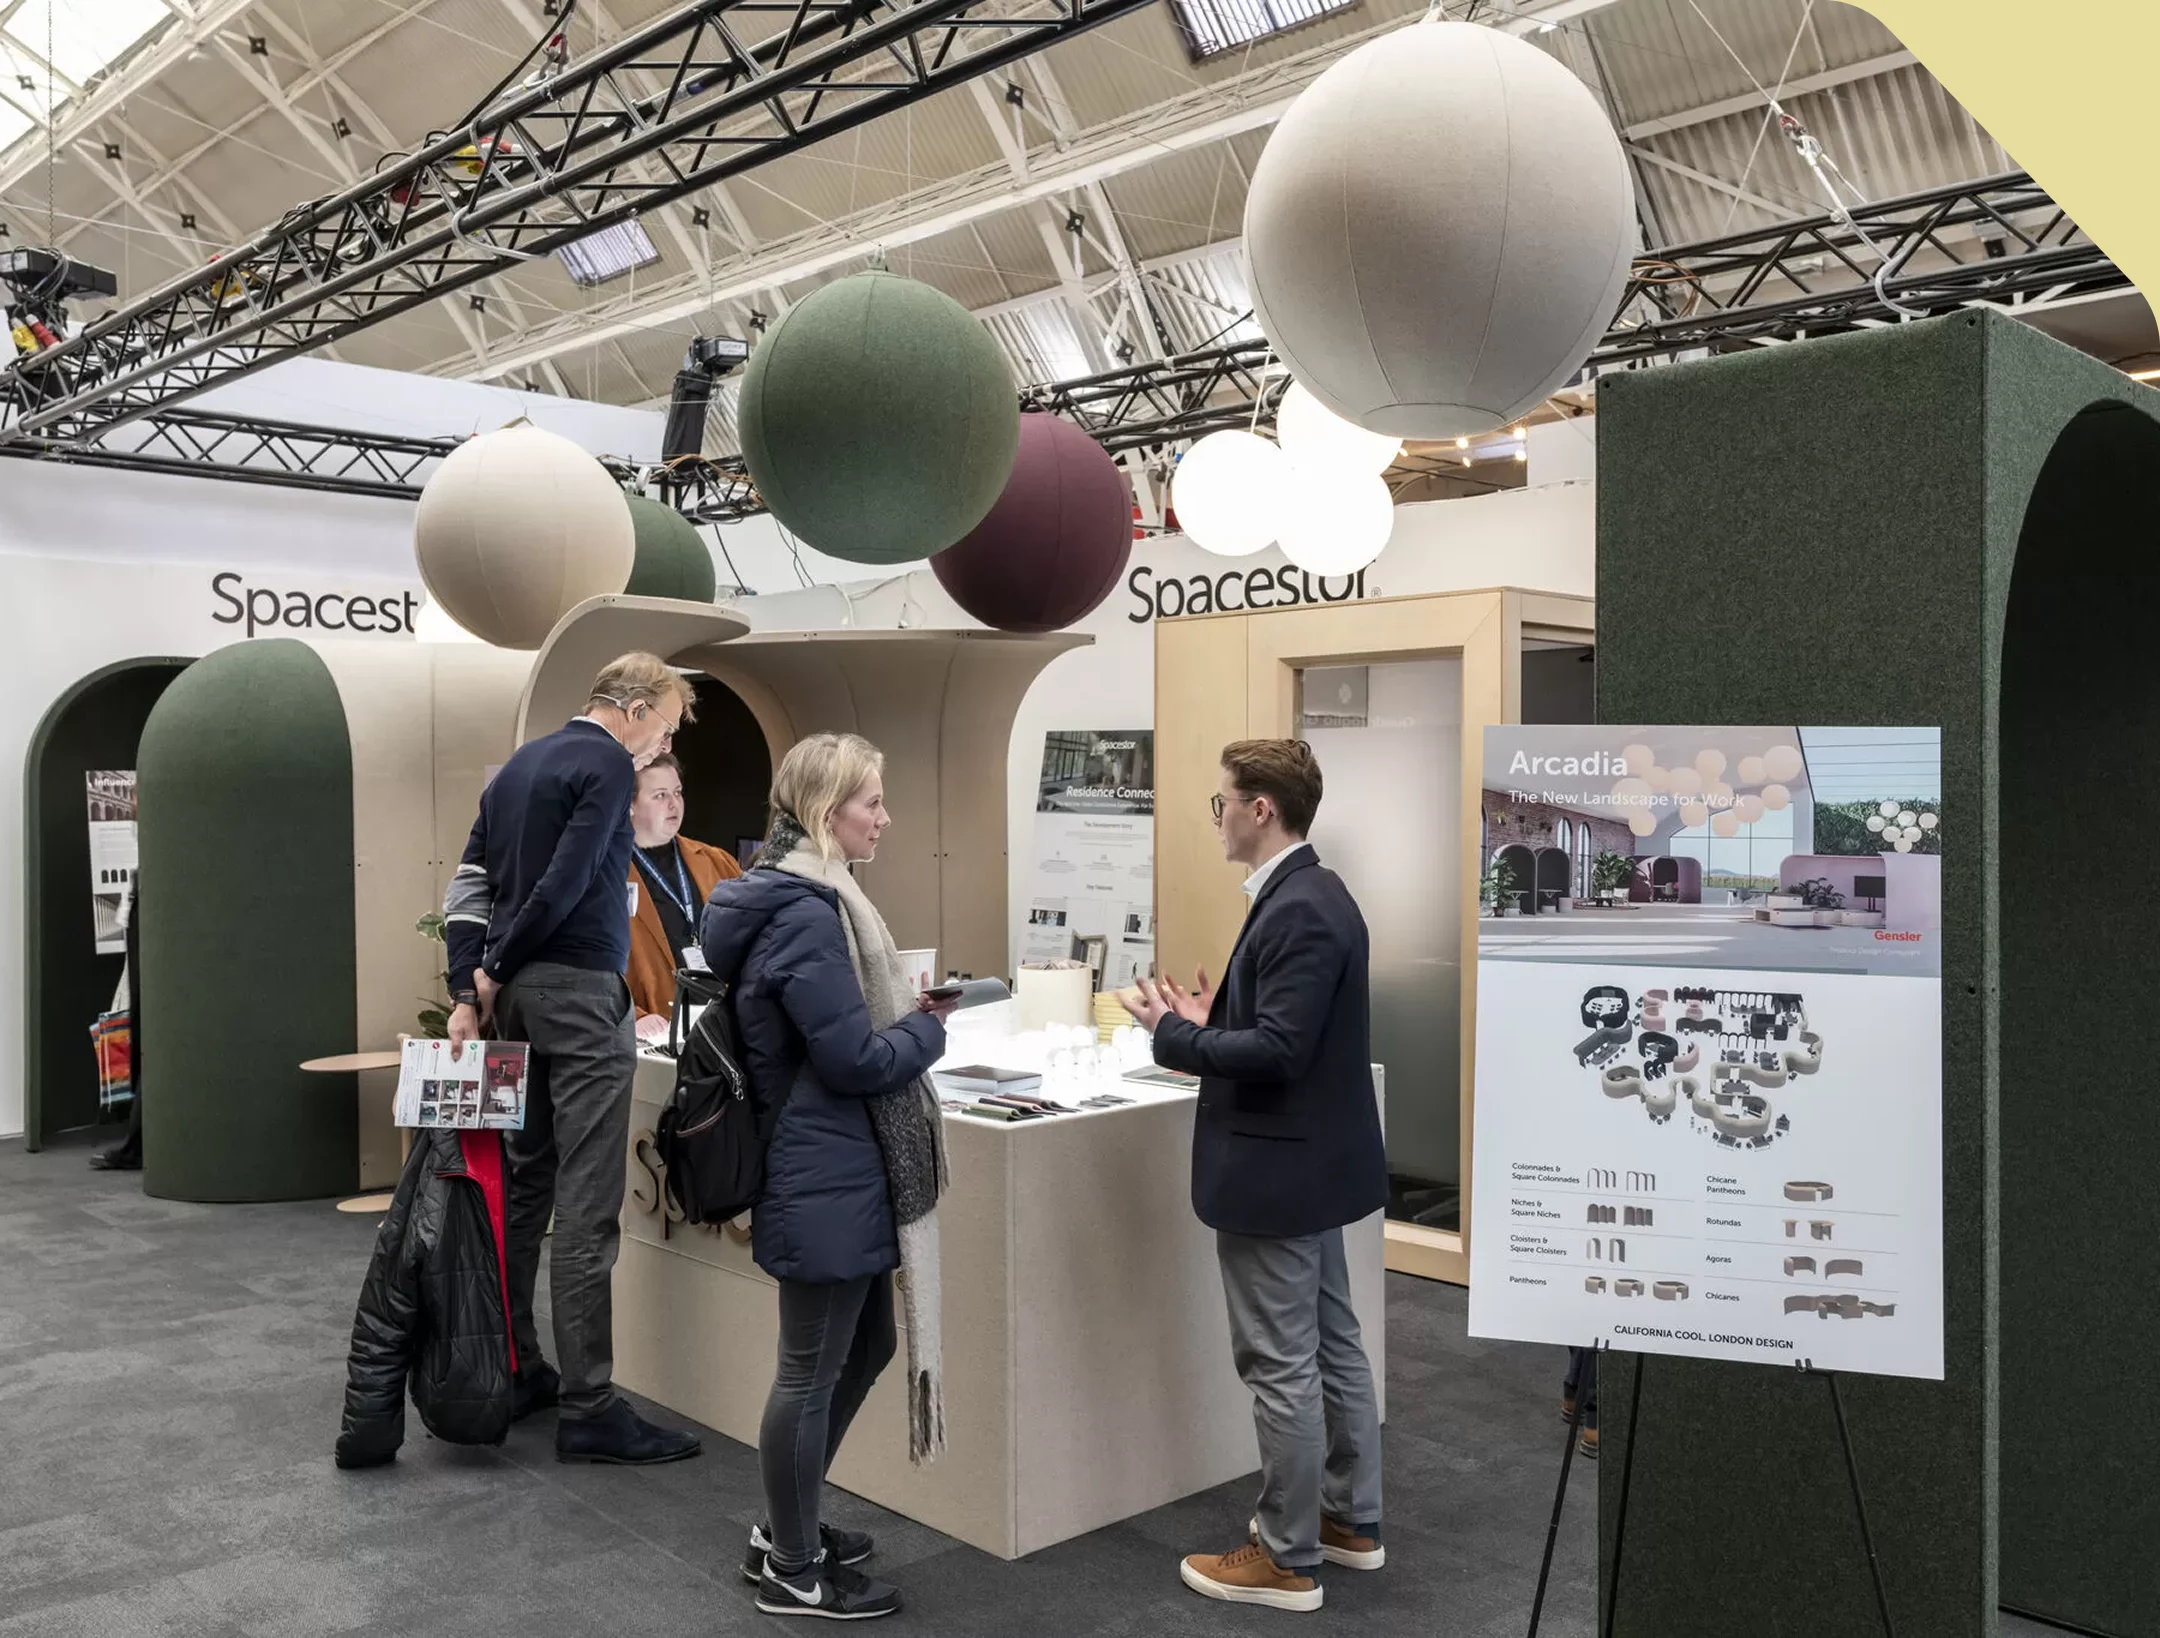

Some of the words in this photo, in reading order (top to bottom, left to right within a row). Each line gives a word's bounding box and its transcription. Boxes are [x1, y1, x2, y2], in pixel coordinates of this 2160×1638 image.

[211, 572, 418, 638] Spacest
[1508, 750, 1628, 776] Arcadia
[94, 778, 135, 787] Influenc
[1066, 785, 1115, 798] Residence
[1116, 786, 1154, 799] Connec
[1508, 790, 1538, 804] The
[1542, 791, 1578, 804] New
[1583, 791, 1668, 808] Landscape
[1673, 794, 1696, 807] for
[1702, 794, 1745, 808] Work
[1874, 930, 1922, 942] Gensler
[1512, 1162, 1554, 1172] Colonnades
[1511, 1172, 1536, 1181] Square
[1537, 1174, 1580, 1184] Colonnades
[1706, 1175, 1737, 1184] Chicane
[1706, 1185, 1746, 1195] Pantheons
[1511, 1198, 1535, 1207] Niches
[1511, 1208, 1535, 1217] Square
[1537, 1211, 1561, 1219] Niches
[1706, 1217, 1741, 1227] Rotundas
[1510, 1234, 1541, 1244] Cloisters
[1510, 1244, 1535, 1254] Square
[1535, 1246, 1567, 1256] Cloisters
[1705, 1255, 1732, 1263] Agoras
[1509, 1276, 1547, 1286] Pantheons
[1705, 1292, 1740, 1302] Chicanes
[1614, 1325, 1673, 1338] CALIFORNIA
[1674, 1331, 1706, 1343] COOL,
[1708, 1334, 1753, 1346] LONDON
[1755, 1338, 1794, 1350] DESIGN
